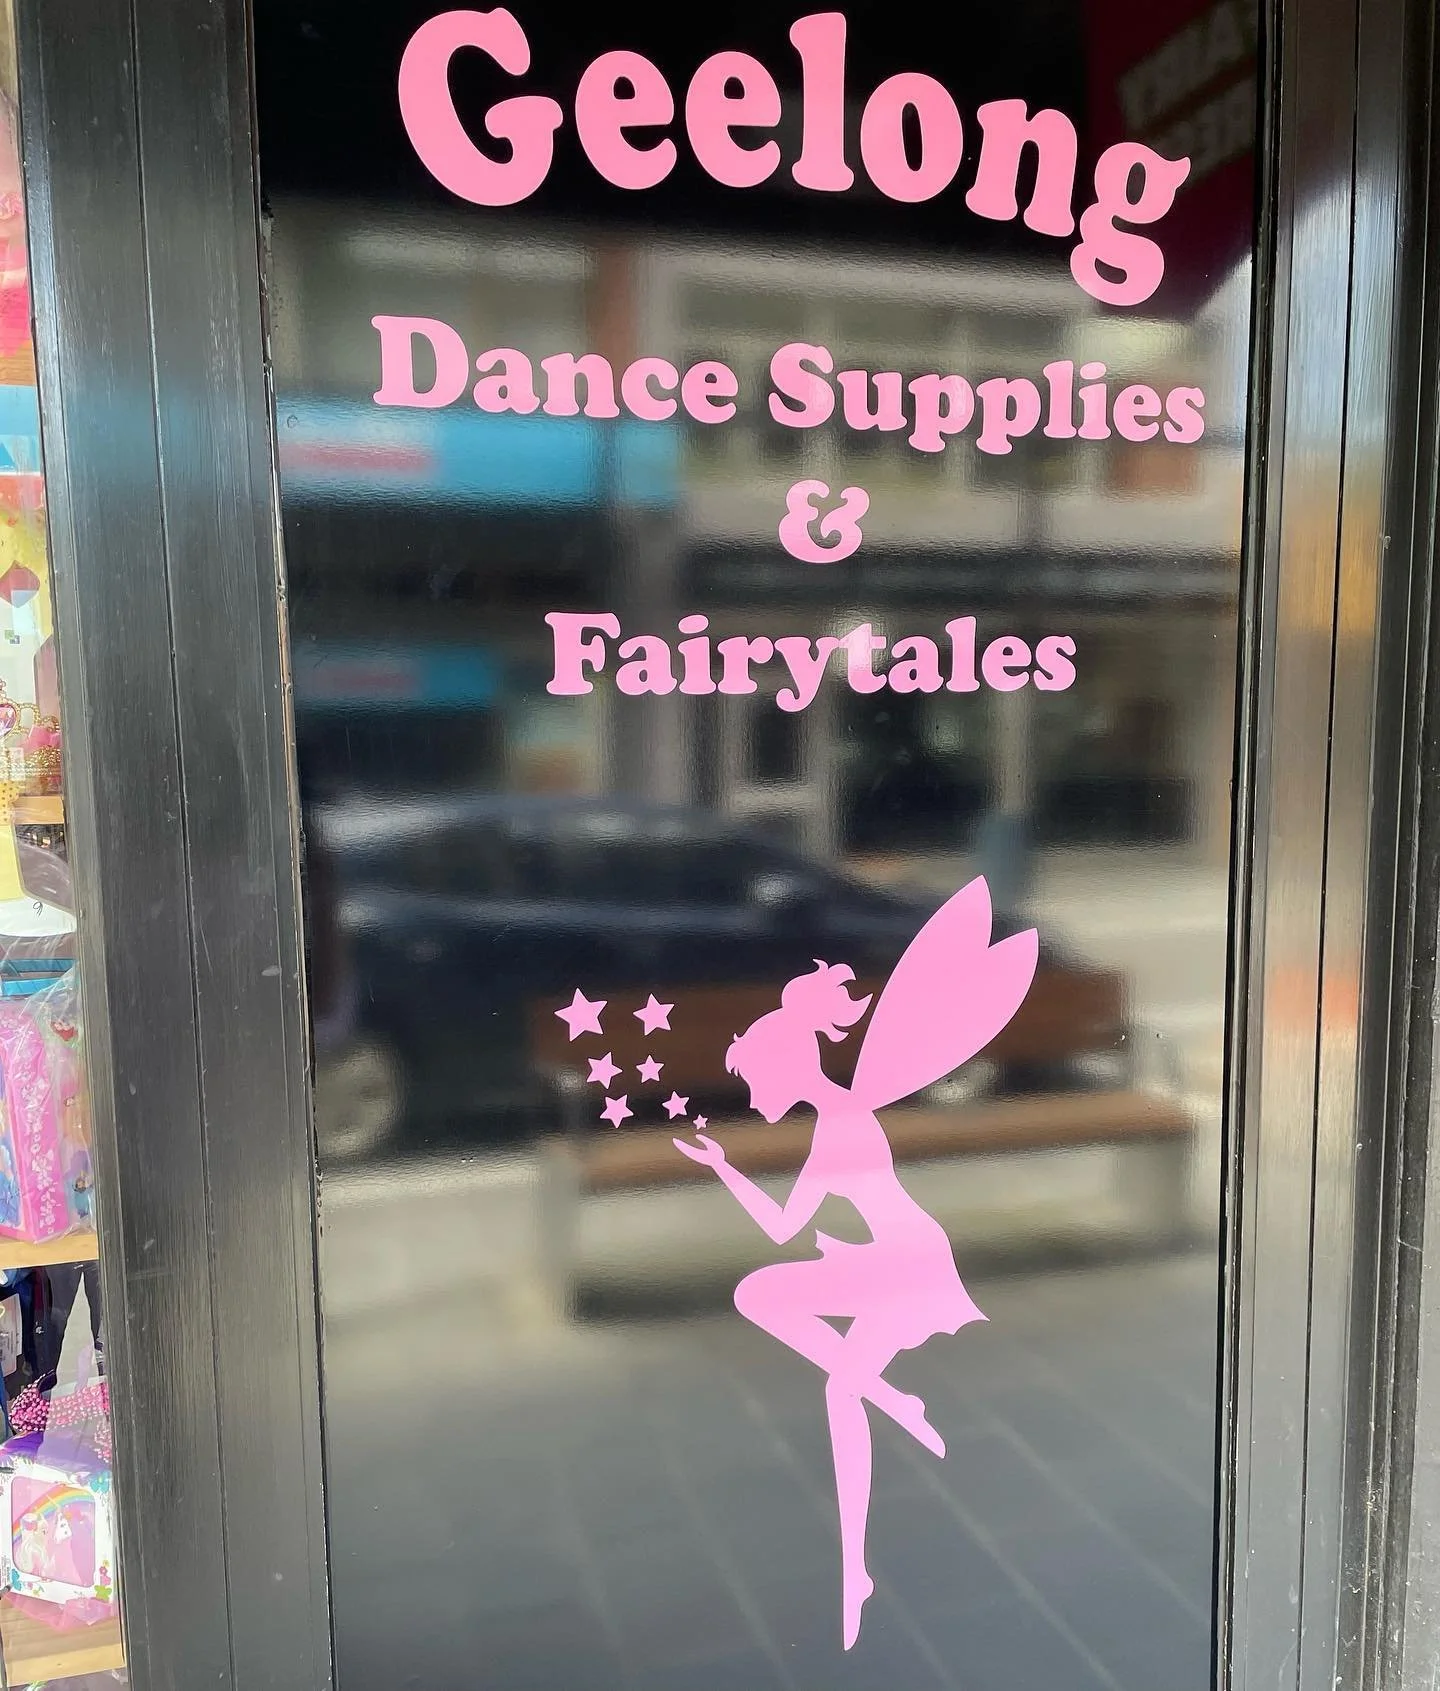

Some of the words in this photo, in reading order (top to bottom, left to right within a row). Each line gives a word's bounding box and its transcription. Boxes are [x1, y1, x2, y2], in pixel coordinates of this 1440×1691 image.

[398, 7, 1191, 306] Geelong
[371, 315, 738, 424] Dance
[768, 342, 1206, 454] Supplies
[778, 480, 870, 564] &
[545, 612, 1077, 712] Fairytales
